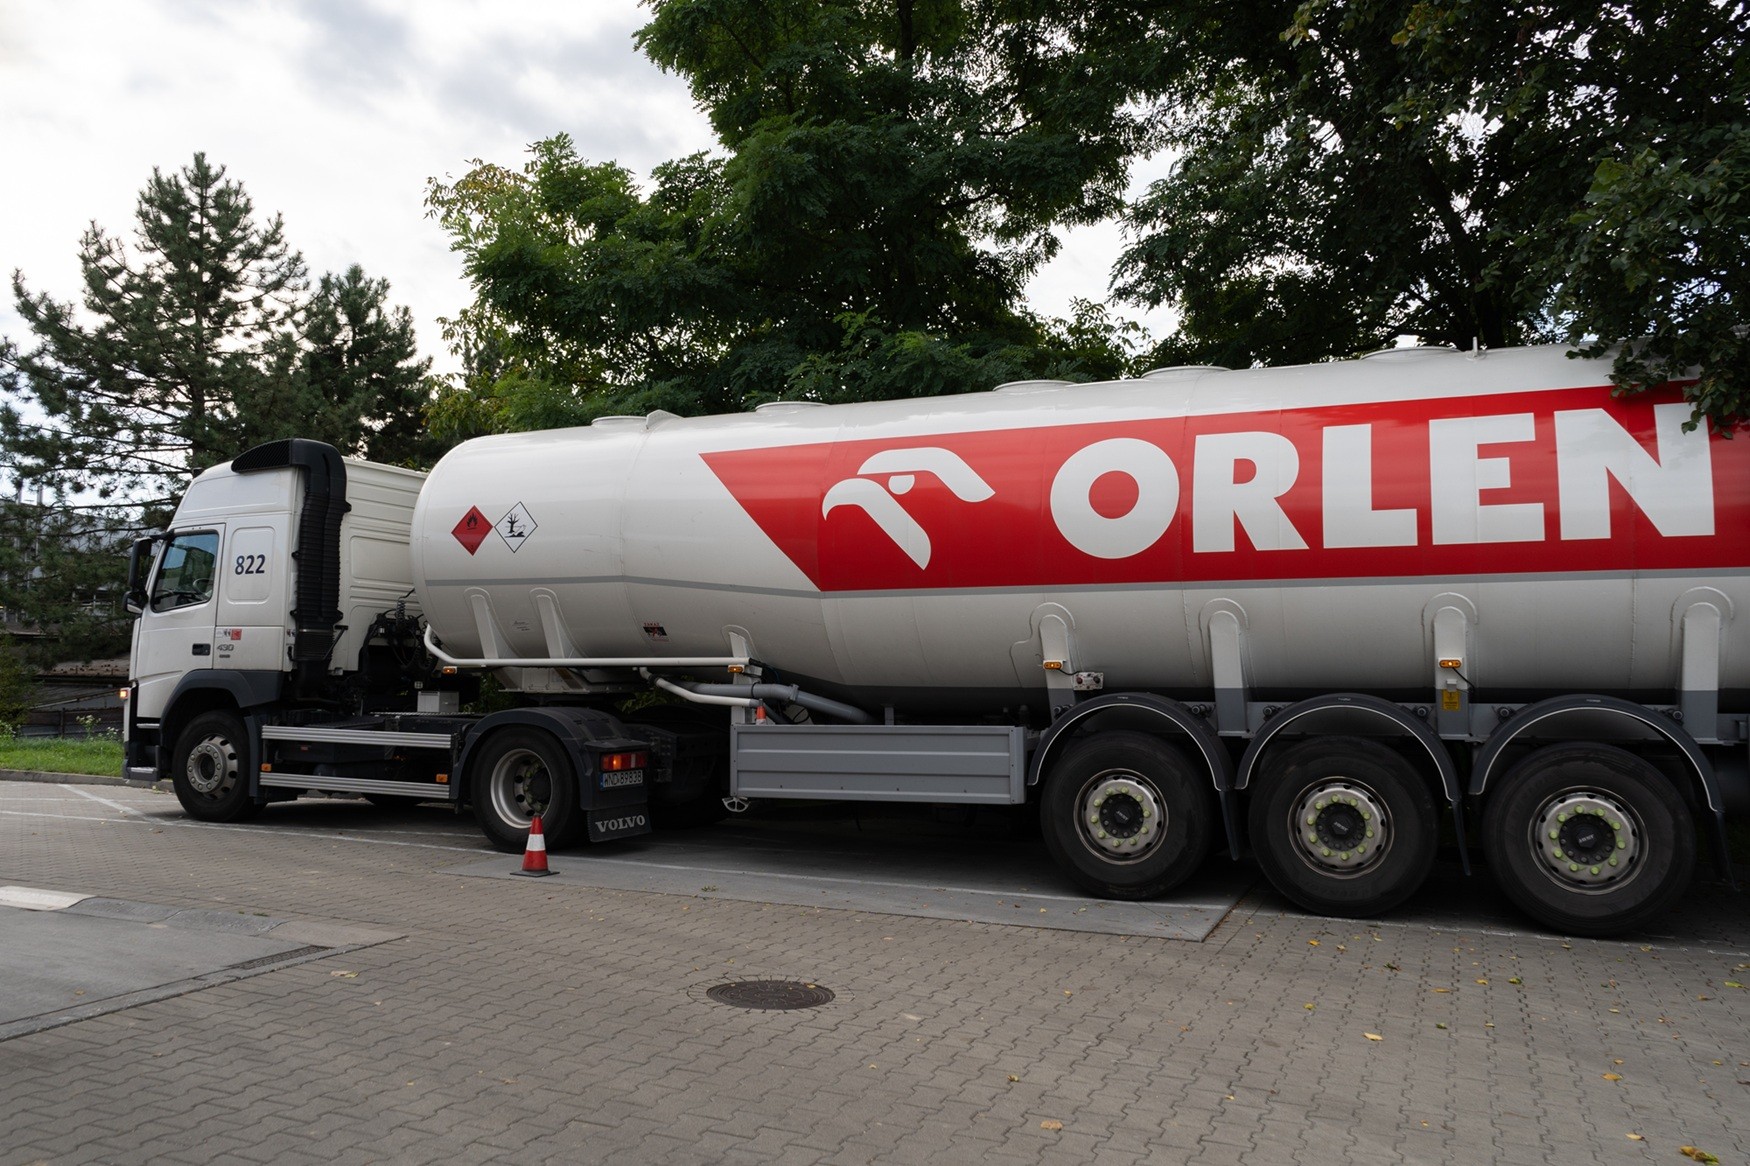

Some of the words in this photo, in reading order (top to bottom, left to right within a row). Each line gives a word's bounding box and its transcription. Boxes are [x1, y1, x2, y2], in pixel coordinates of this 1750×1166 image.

[1050, 403, 1715, 560] ORLEN
[235, 554, 266, 575] 822
[595, 815, 646, 833] VOLVO
